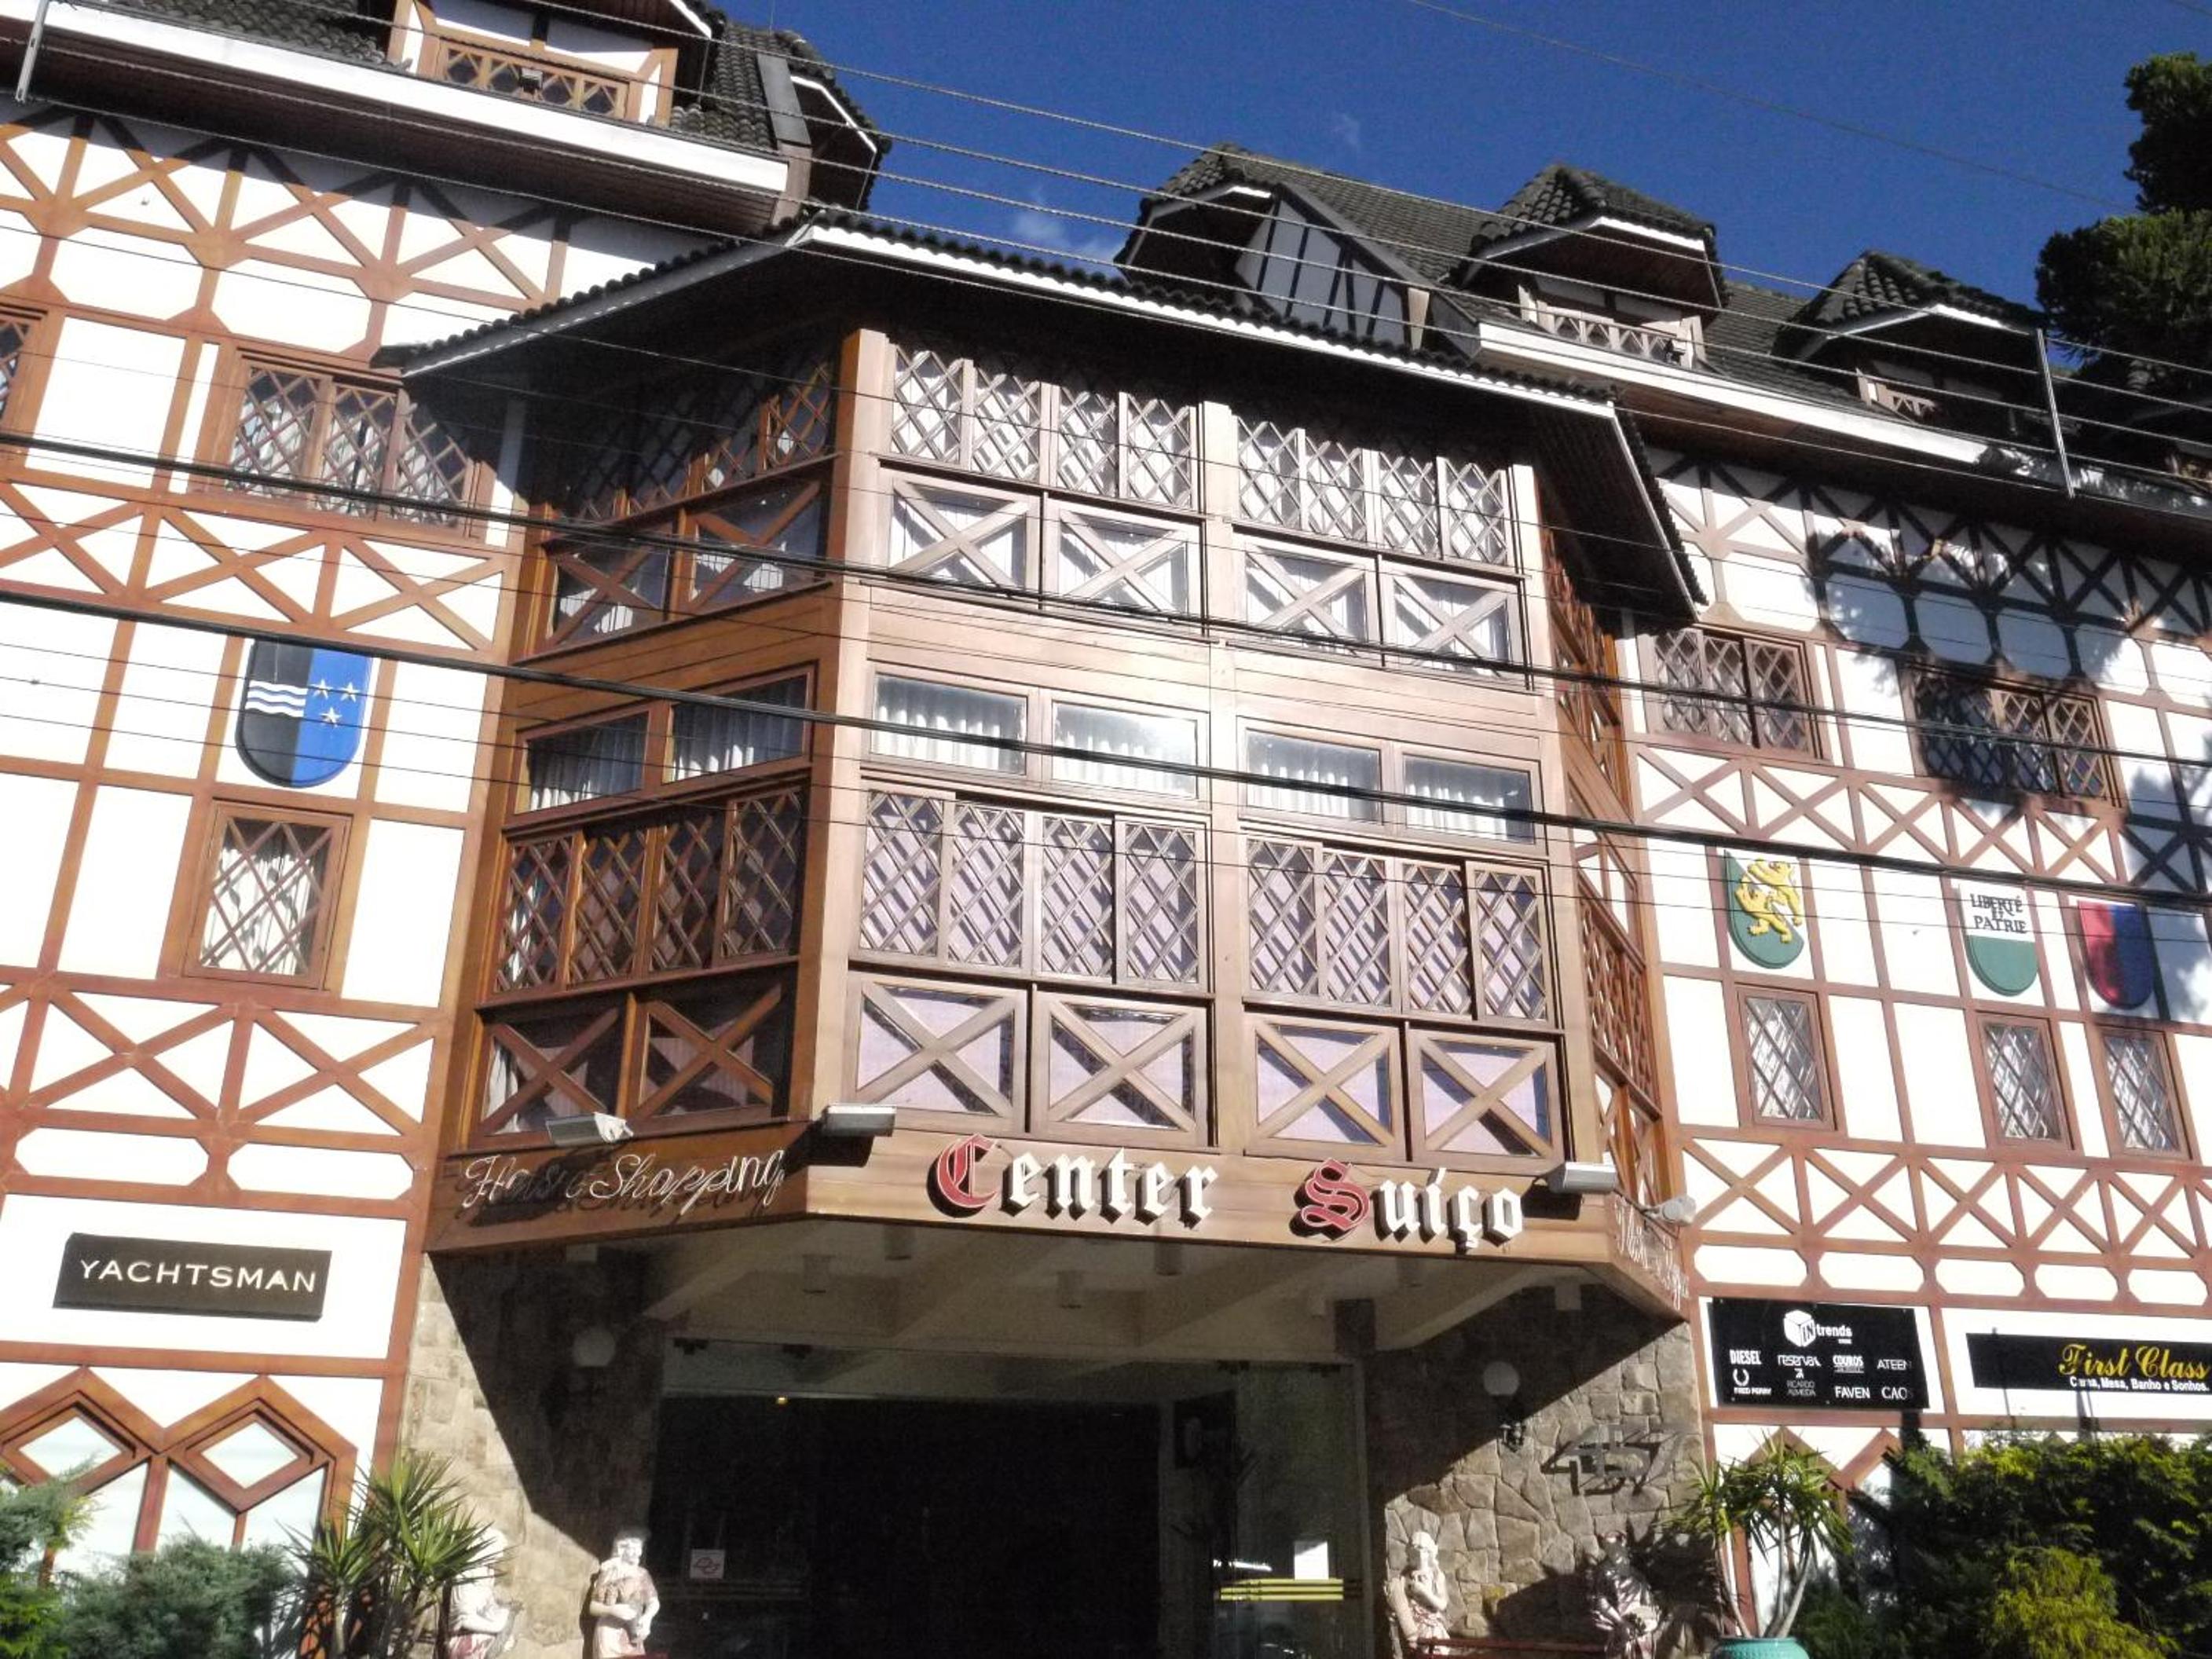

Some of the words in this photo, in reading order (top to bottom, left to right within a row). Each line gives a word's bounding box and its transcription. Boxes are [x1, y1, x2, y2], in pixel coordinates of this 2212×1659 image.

[1969, 894, 2023, 916] LIBERTÉ
[1973, 915, 2027, 933] PATRIE
[589, 1149, 786, 1217] Shopping
[937, 1132, 1218, 1219] Center
[1300, 1158, 1524, 1249] Suíço
[80, 1258, 316, 1293] YACHTSMAN
[1816, 1324, 1853, 1337] trends
[1729, 1349, 1762, 1365] DIESEL
[2058, 1343, 2131, 1375] First
[2135, 1345, 2210, 1379] Class
[1834, 1386, 1870, 1399] FAVEN
[2130, 1378, 2162, 1390] Banho
